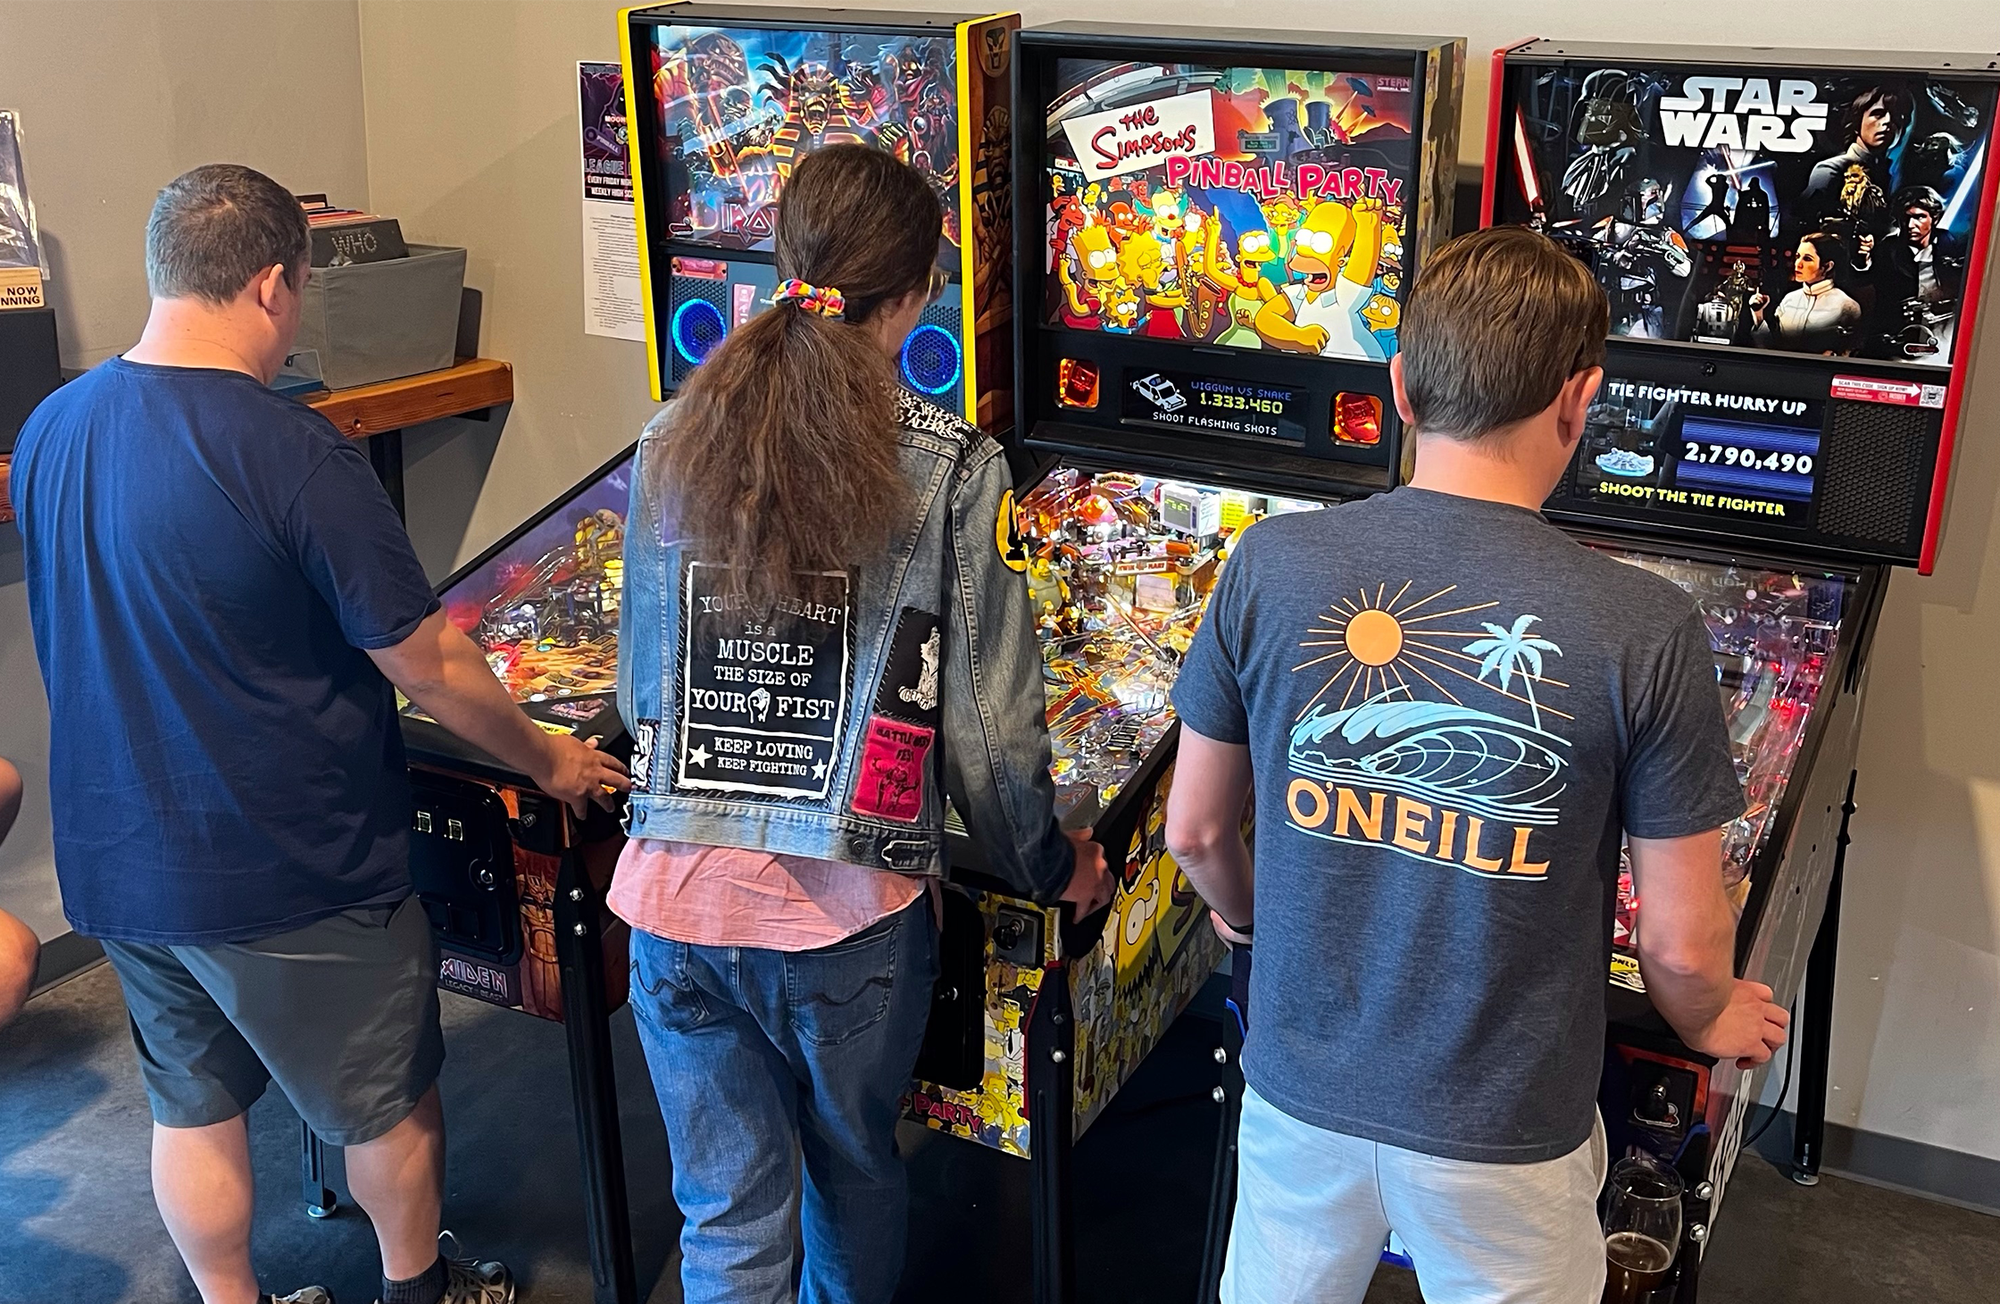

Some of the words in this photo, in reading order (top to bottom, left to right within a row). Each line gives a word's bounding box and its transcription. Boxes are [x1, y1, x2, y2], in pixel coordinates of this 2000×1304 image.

[1378, 77, 1410, 87] STERN
[1660, 76, 1829, 117] STAR
[1119, 105, 1159, 131] THE
[1659, 110, 1827, 153] WARS
[1091, 124, 1197, 169] SIMPSONS
[584, 158, 624, 175] LEAGUE
[1165, 155, 1291, 198] PINBALL
[1297, 163, 1402, 205] PARTY
[331, 232, 377, 255] WHO
[6, 286, 38, 296] NOW
[1191, 381, 1233, 394] WIGGUM
[1237, 387, 1253, 397] VS
[1257, 389, 1292, 401] SNAKE
[1608, 382, 1635, 398] TIE
[1638, 385, 1712, 406] FIGHTER
[1715, 394, 1779, 413] HURRY
[1782, 400, 1807, 416] UP
[1152, 411, 1184, 424] SHOOT
[1188, 416, 1240, 431] FLASHING
[1243, 423, 1278, 436] SHOTS
[1684, 441, 1813, 475] 2,790,490
[1599, 480, 1654, 499] SHOOT
[1657, 488, 1687, 504] THE
[1690, 492, 1715, 508] TIE
[1718, 497, 1786, 517] FIGHTER
[775, 594, 841, 624] HEART
[744, 621, 763, 635] is
[766, 625, 777, 637] a
[717, 638, 814, 666] MUSCLE
[713, 665, 744, 682] THE
[747, 669, 786, 686] SIZE
[790, 672, 812, 687] OF
[691, 688, 748, 714] YOUR
[776, 696, 835, 720] FIST
[714, 737, 753, 754] KEEP
[756, 740, 813, 760] LOVING
[717, 756, 747, 770] KEEP
[749, 760, 807, 776] FIGHTING
[1286, 777, 1551, 875] O'NEILL
[440, 957, 508, 999] AIDEN
[913, 1091, 983, 1133] PARTY
